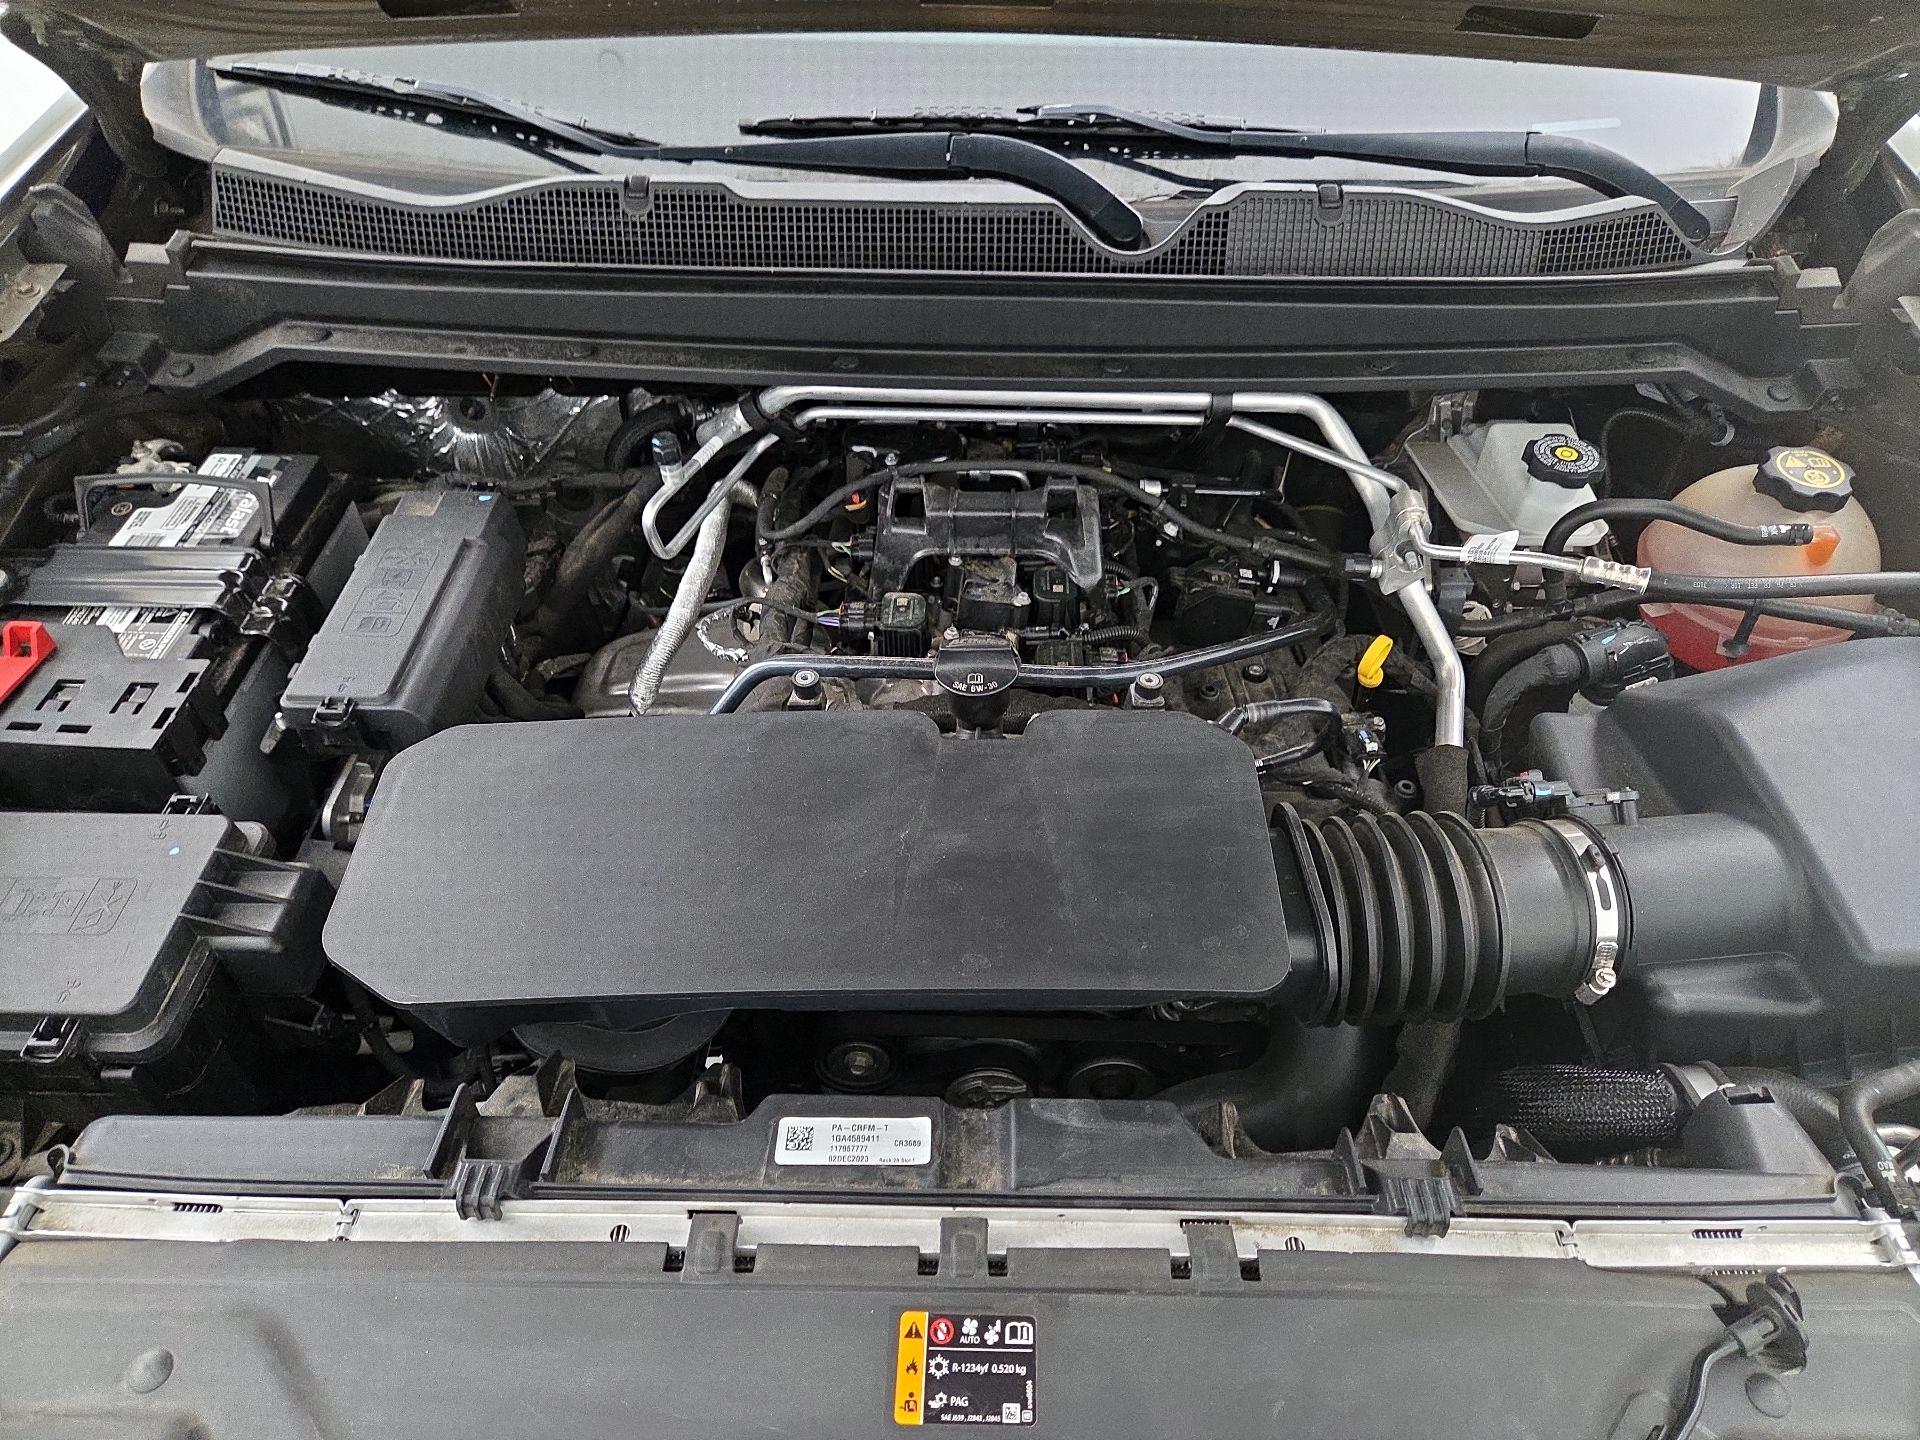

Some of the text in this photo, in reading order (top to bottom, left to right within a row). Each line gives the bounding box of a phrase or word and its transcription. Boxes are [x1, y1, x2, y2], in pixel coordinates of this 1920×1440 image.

[953, 681, 967, 692] SAE
[828, 1155, 869, 1163] 02DEC2023
[960, 1335, 980, 1344] AUTO
[952, 1362, 1027, 1376] R-1234yf 0.520 kg
[950, 1396, 969, 1407] PAG
[940, 1413, 951, 1422] SAE
